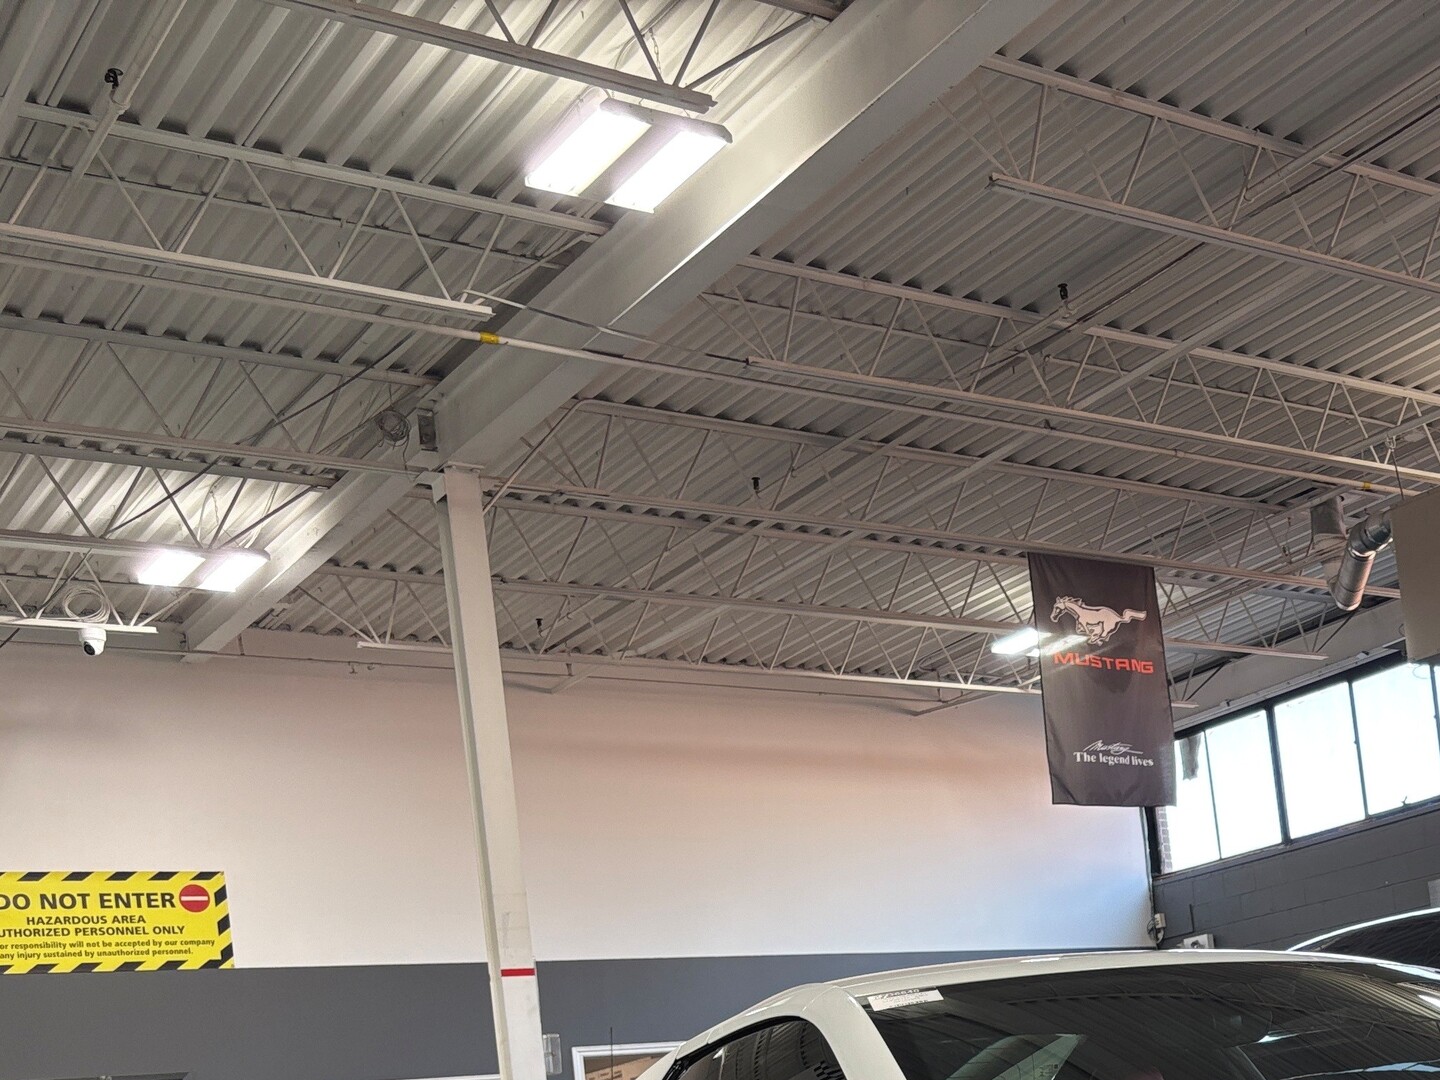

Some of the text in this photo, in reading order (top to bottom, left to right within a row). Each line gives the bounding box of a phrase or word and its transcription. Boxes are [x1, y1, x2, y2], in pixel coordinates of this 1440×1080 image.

[1054, 651, 1154, 674] MUSTANG
[1073, 751, 1154, 766] The legend lives
[0, 892, 176, 910] DO NOT ENTER
[26, 915, 147, 926] HAZARDOUS AREA
[0, 925, 185, 938] UTHORIZED PERSONNEL ONLY
[11, 941, 67, 951] responsibility
[69, 940, 84, 948] will
[114, 940, 150, 948] accepted
[152, 939, 162, 948] by
[0, 952, 15, 960] any
[17, 952, 41, 960] injury
[43, 950, 83, 958] sustained
[84, 950, 95, 958] by
[97, 949, 150, 957] unauthorized
